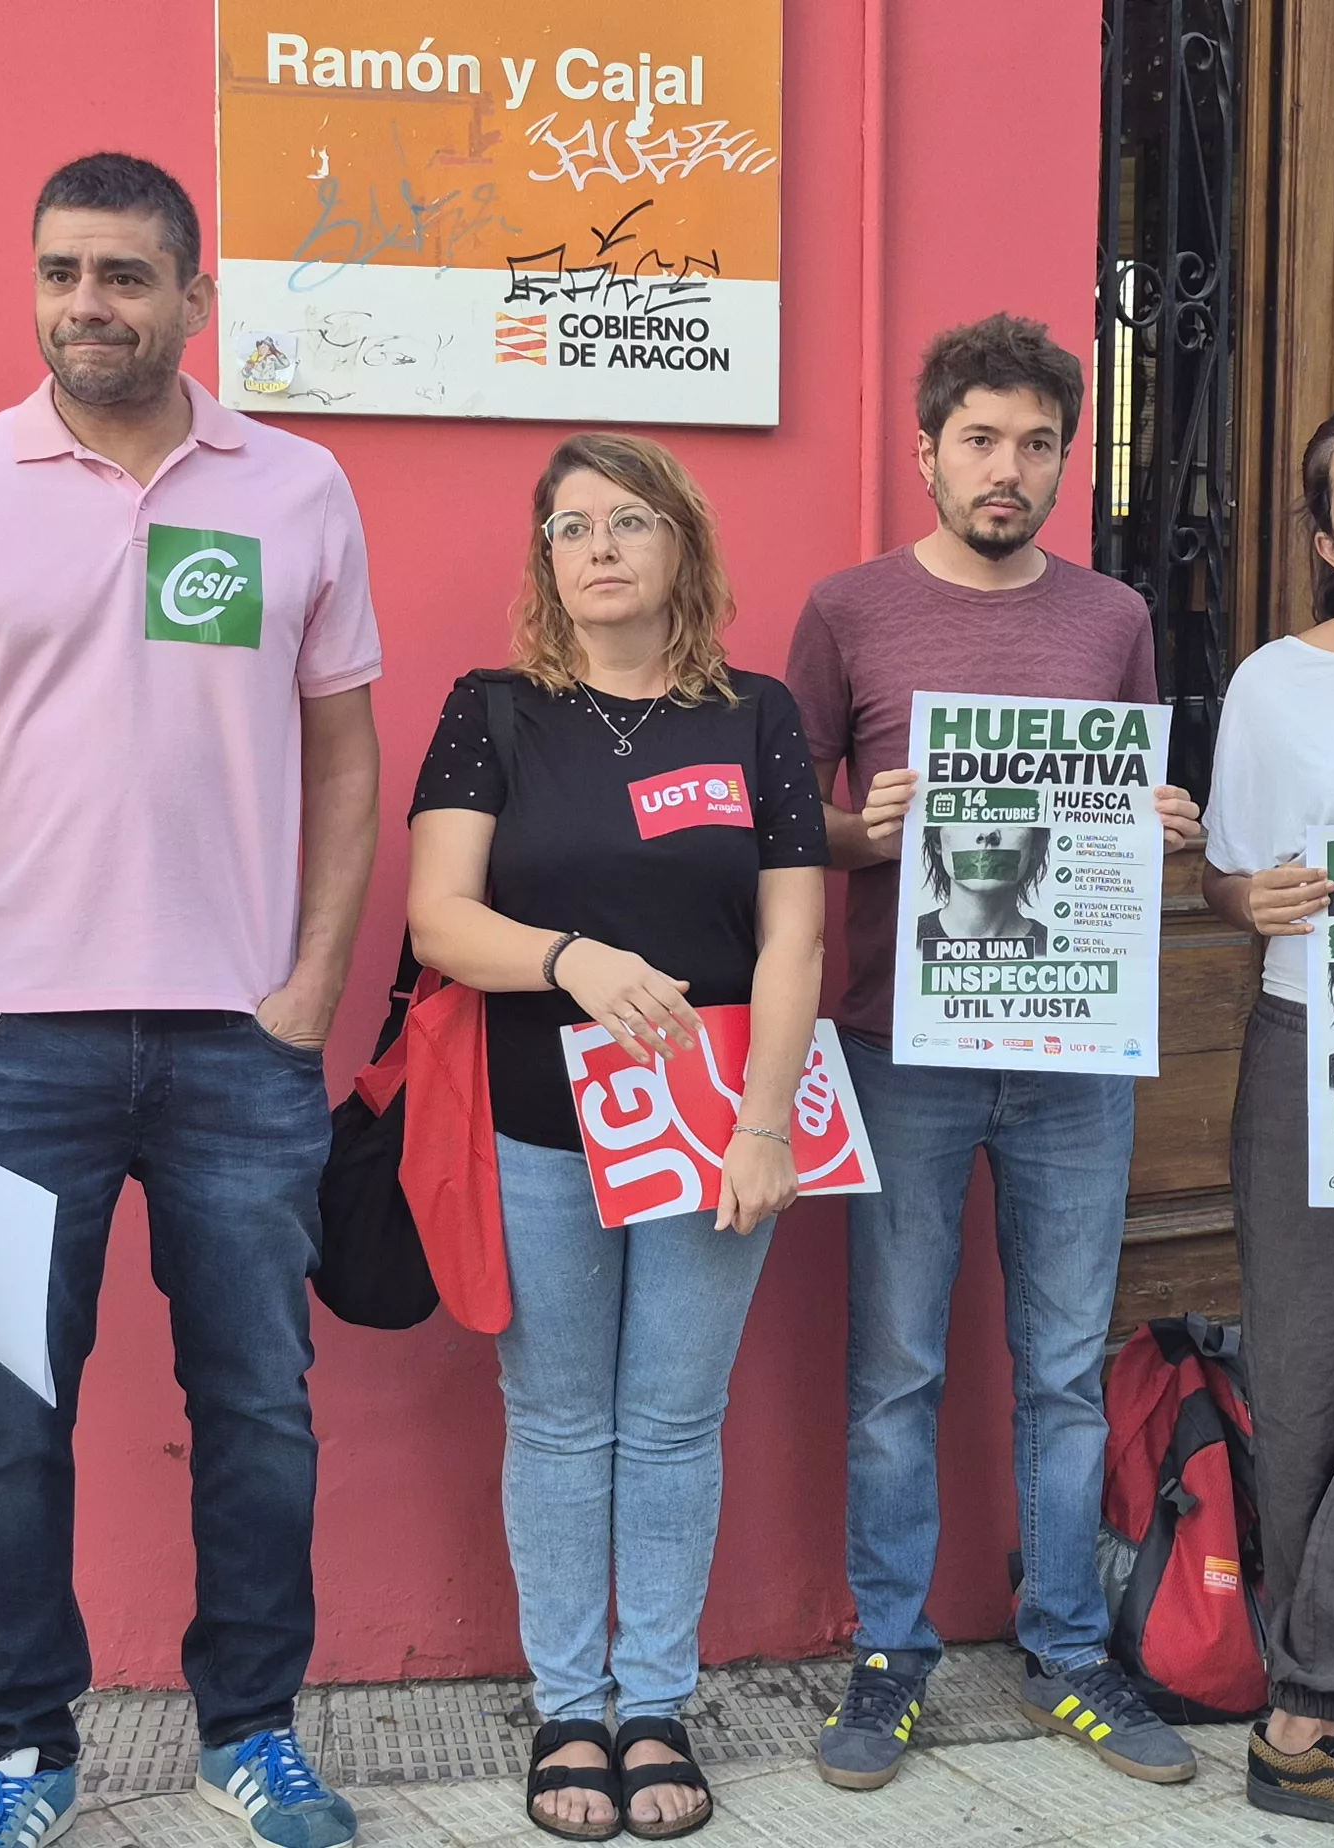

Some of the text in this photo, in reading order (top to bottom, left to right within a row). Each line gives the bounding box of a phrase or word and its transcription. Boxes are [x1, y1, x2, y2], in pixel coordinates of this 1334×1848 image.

[268, 32, 704, 112] Ramón y Cajal
[559, 313, 709, 342] GOBIERNO
[559, 342, 730, 372] DE ARAGON
[178, 570, 249, 601] CSIF
[929, 708, 1151, 751] HUELGA
[928, 752, 1149, 787] EDUCATIVA
[640, 780, 699, 813] UGT
[707, 802, 743, 814] Aragón
[962, 790, 987, 807] 14
[1053, 791, 1131, 811] HUESCA
[962, 807, 1036, 821] DE OCTUBRE
[1053, 811, 1135, 825] Y PROVINCIA
[1075, 868, 1120, 876] UNIFICACIÓN
[1110, 904, 1142, 912] EXTERNA
[936, 940, 1027, 960] POR UNA
[931, 962, 1109, 993] INSPECCIÓN
[944, 995, 1091, 1019] ÚTIL Y JUSTA
